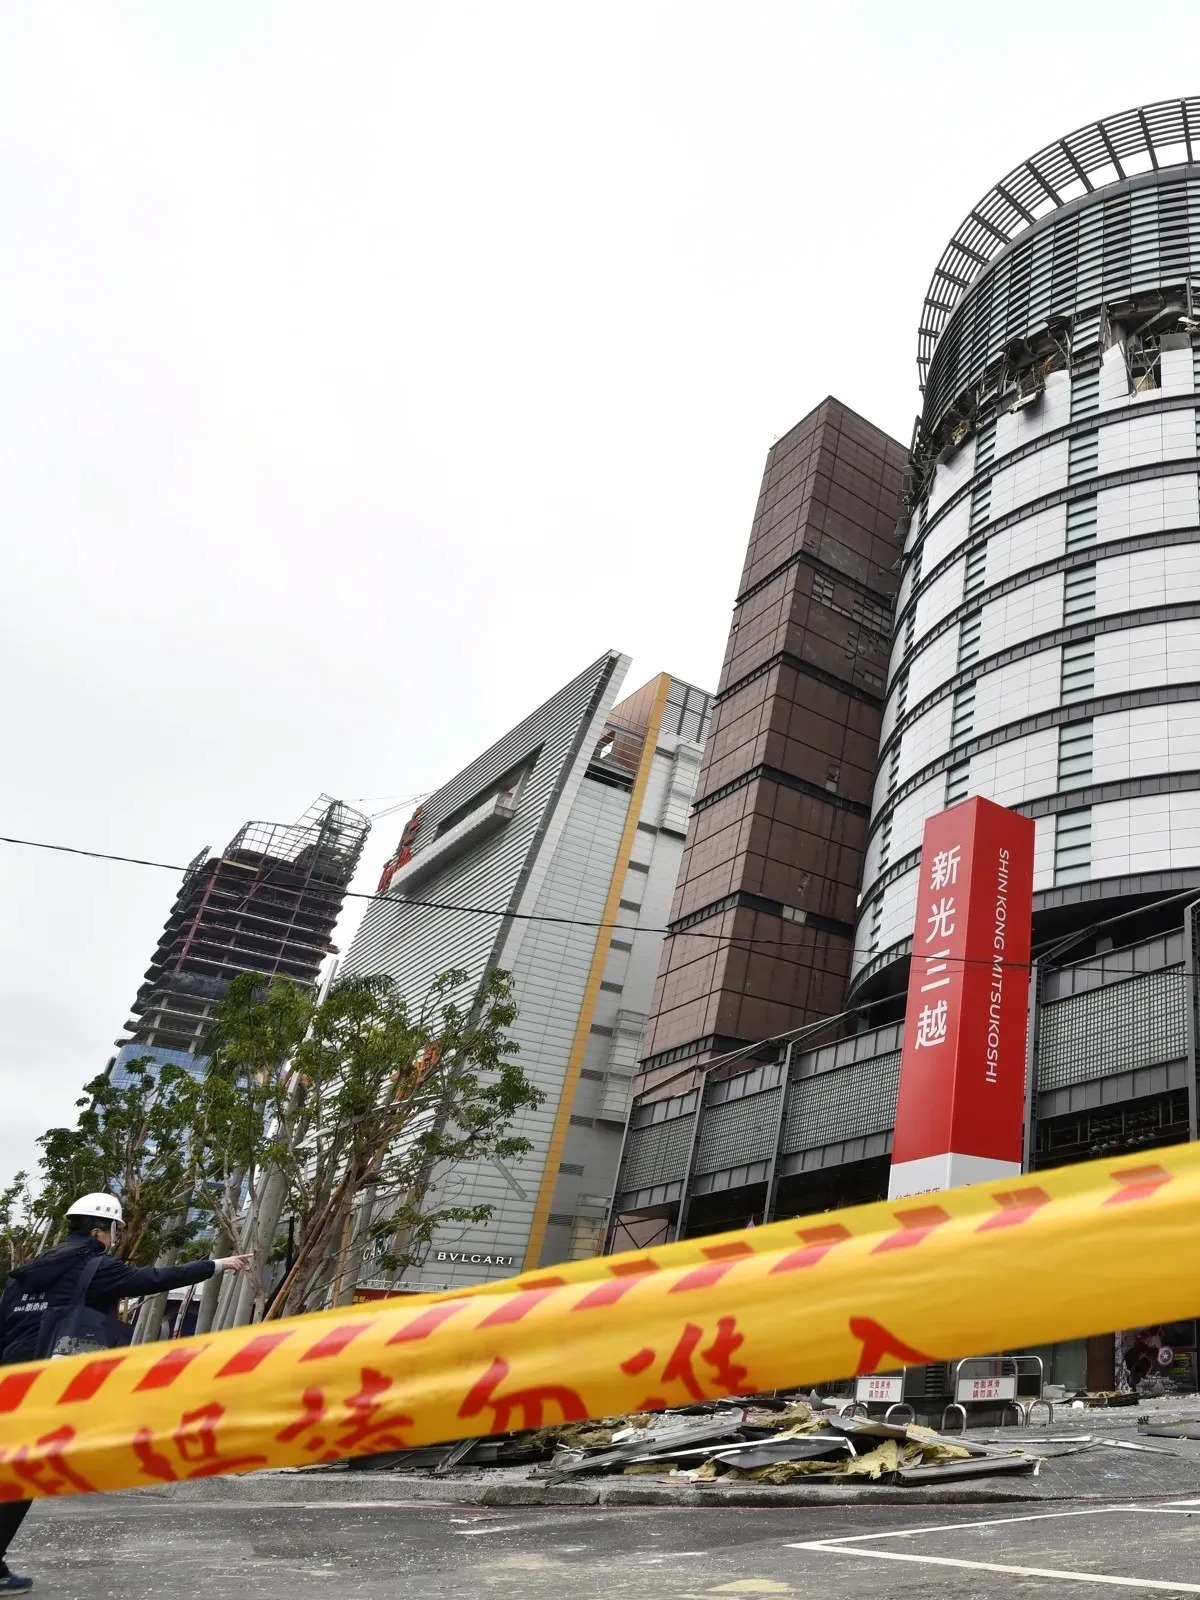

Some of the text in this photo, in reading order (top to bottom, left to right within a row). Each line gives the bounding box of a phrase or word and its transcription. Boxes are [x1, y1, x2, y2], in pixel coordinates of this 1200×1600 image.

[915, 844, 961, 1050] 新光三越
[985, 848, 1009, 1083] SHIN KONG MITSUKOSHI
[437, 1251, 513, 1266] BVLGARI
[973, 1380, 1000, 1389] 地面濕滑
[972, 1389, 1000, 1398] 請勿進入
